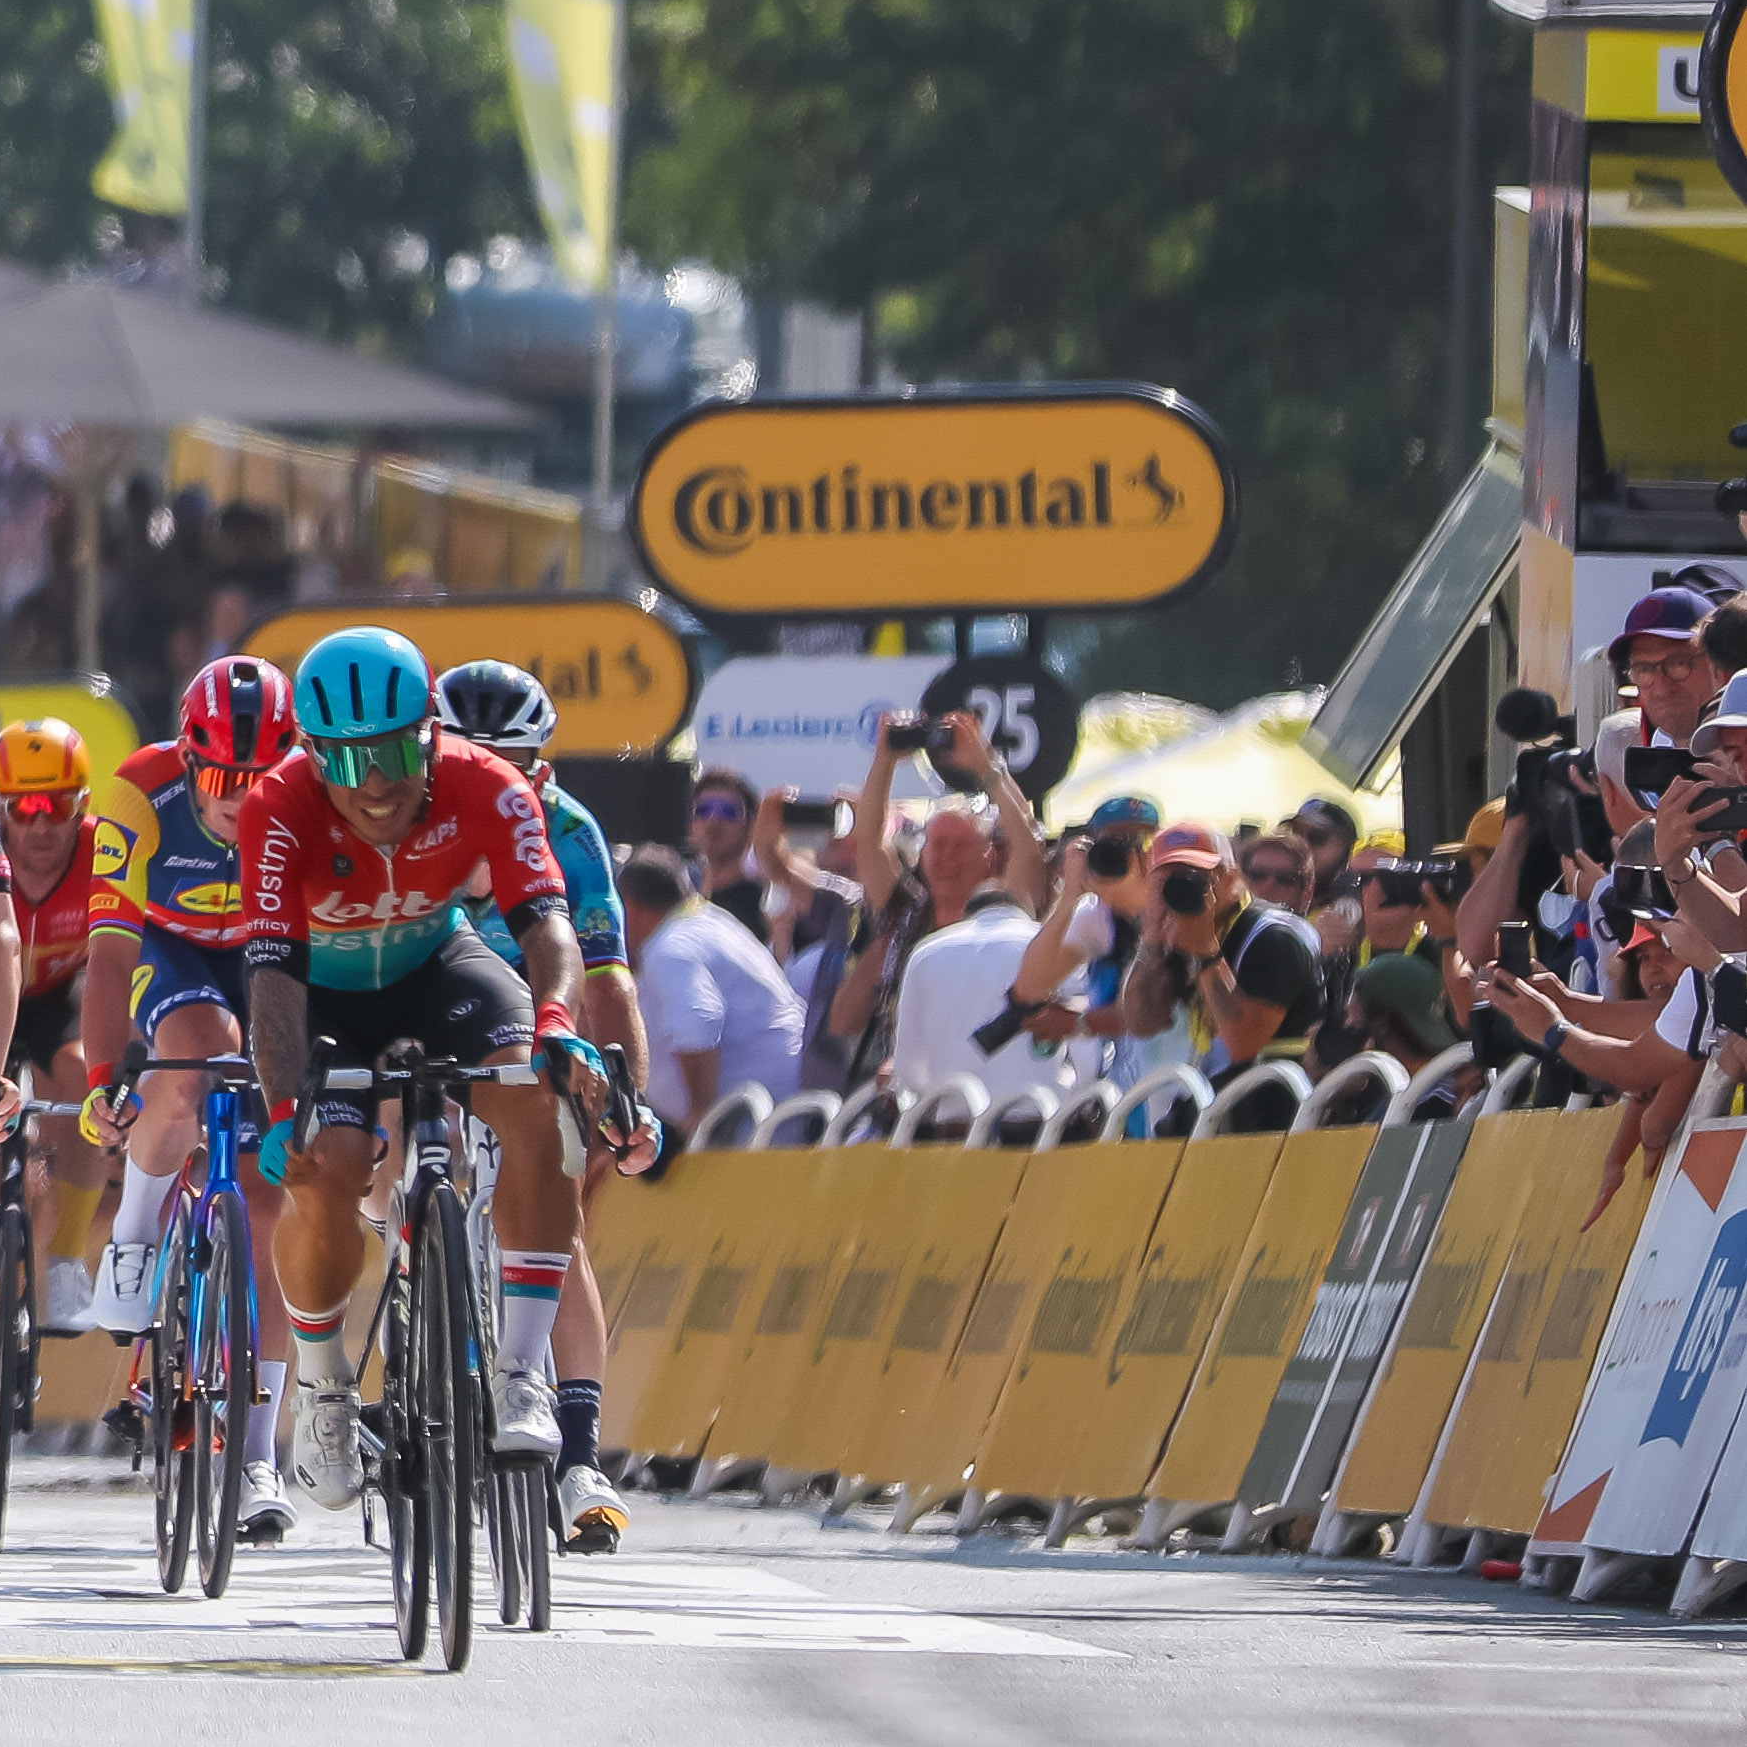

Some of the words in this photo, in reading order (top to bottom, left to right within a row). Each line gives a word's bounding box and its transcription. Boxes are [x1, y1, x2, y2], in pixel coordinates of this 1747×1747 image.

[672, 458, 1112, 555] Continental
[255, 815, 300, 912] dstny
[246, 917, 291, 935] officy
